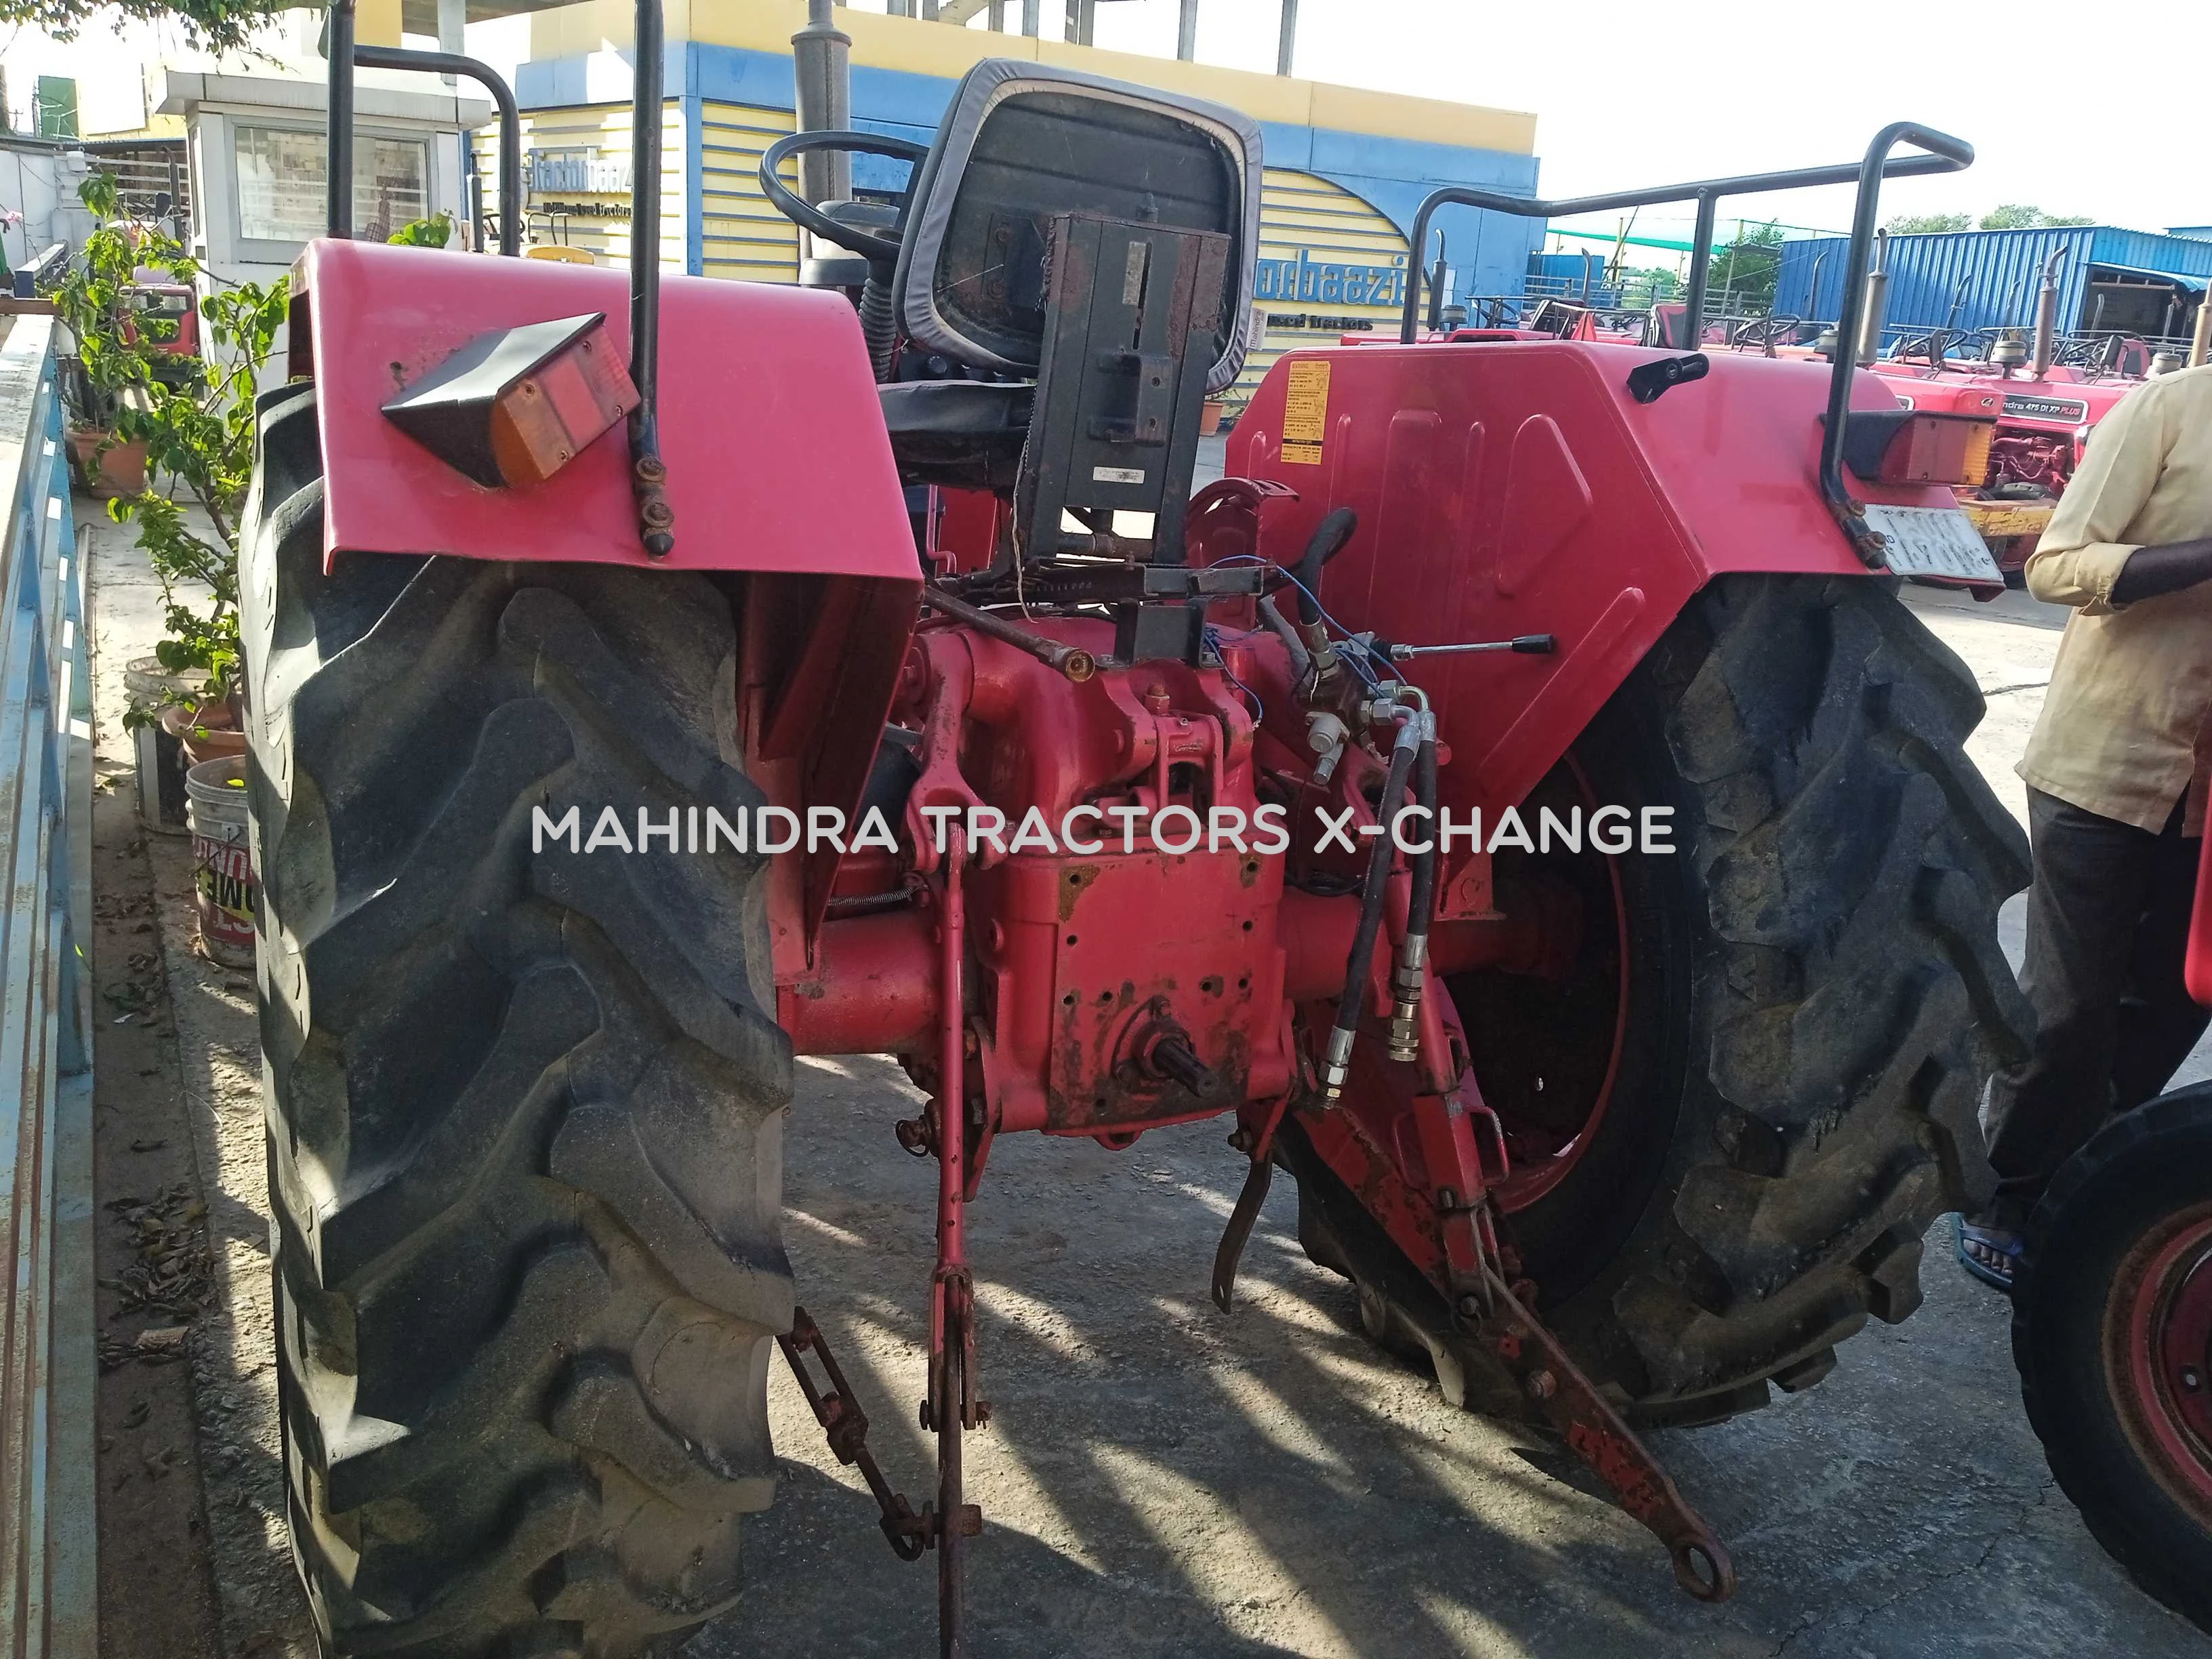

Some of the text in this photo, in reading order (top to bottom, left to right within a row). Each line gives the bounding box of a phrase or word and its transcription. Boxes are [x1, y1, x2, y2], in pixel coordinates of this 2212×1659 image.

[1310, 315, 1373, 331] tractors
[2026, 403, 2039, 411] 475
[2060, 407, 2081, 415] PLUS
